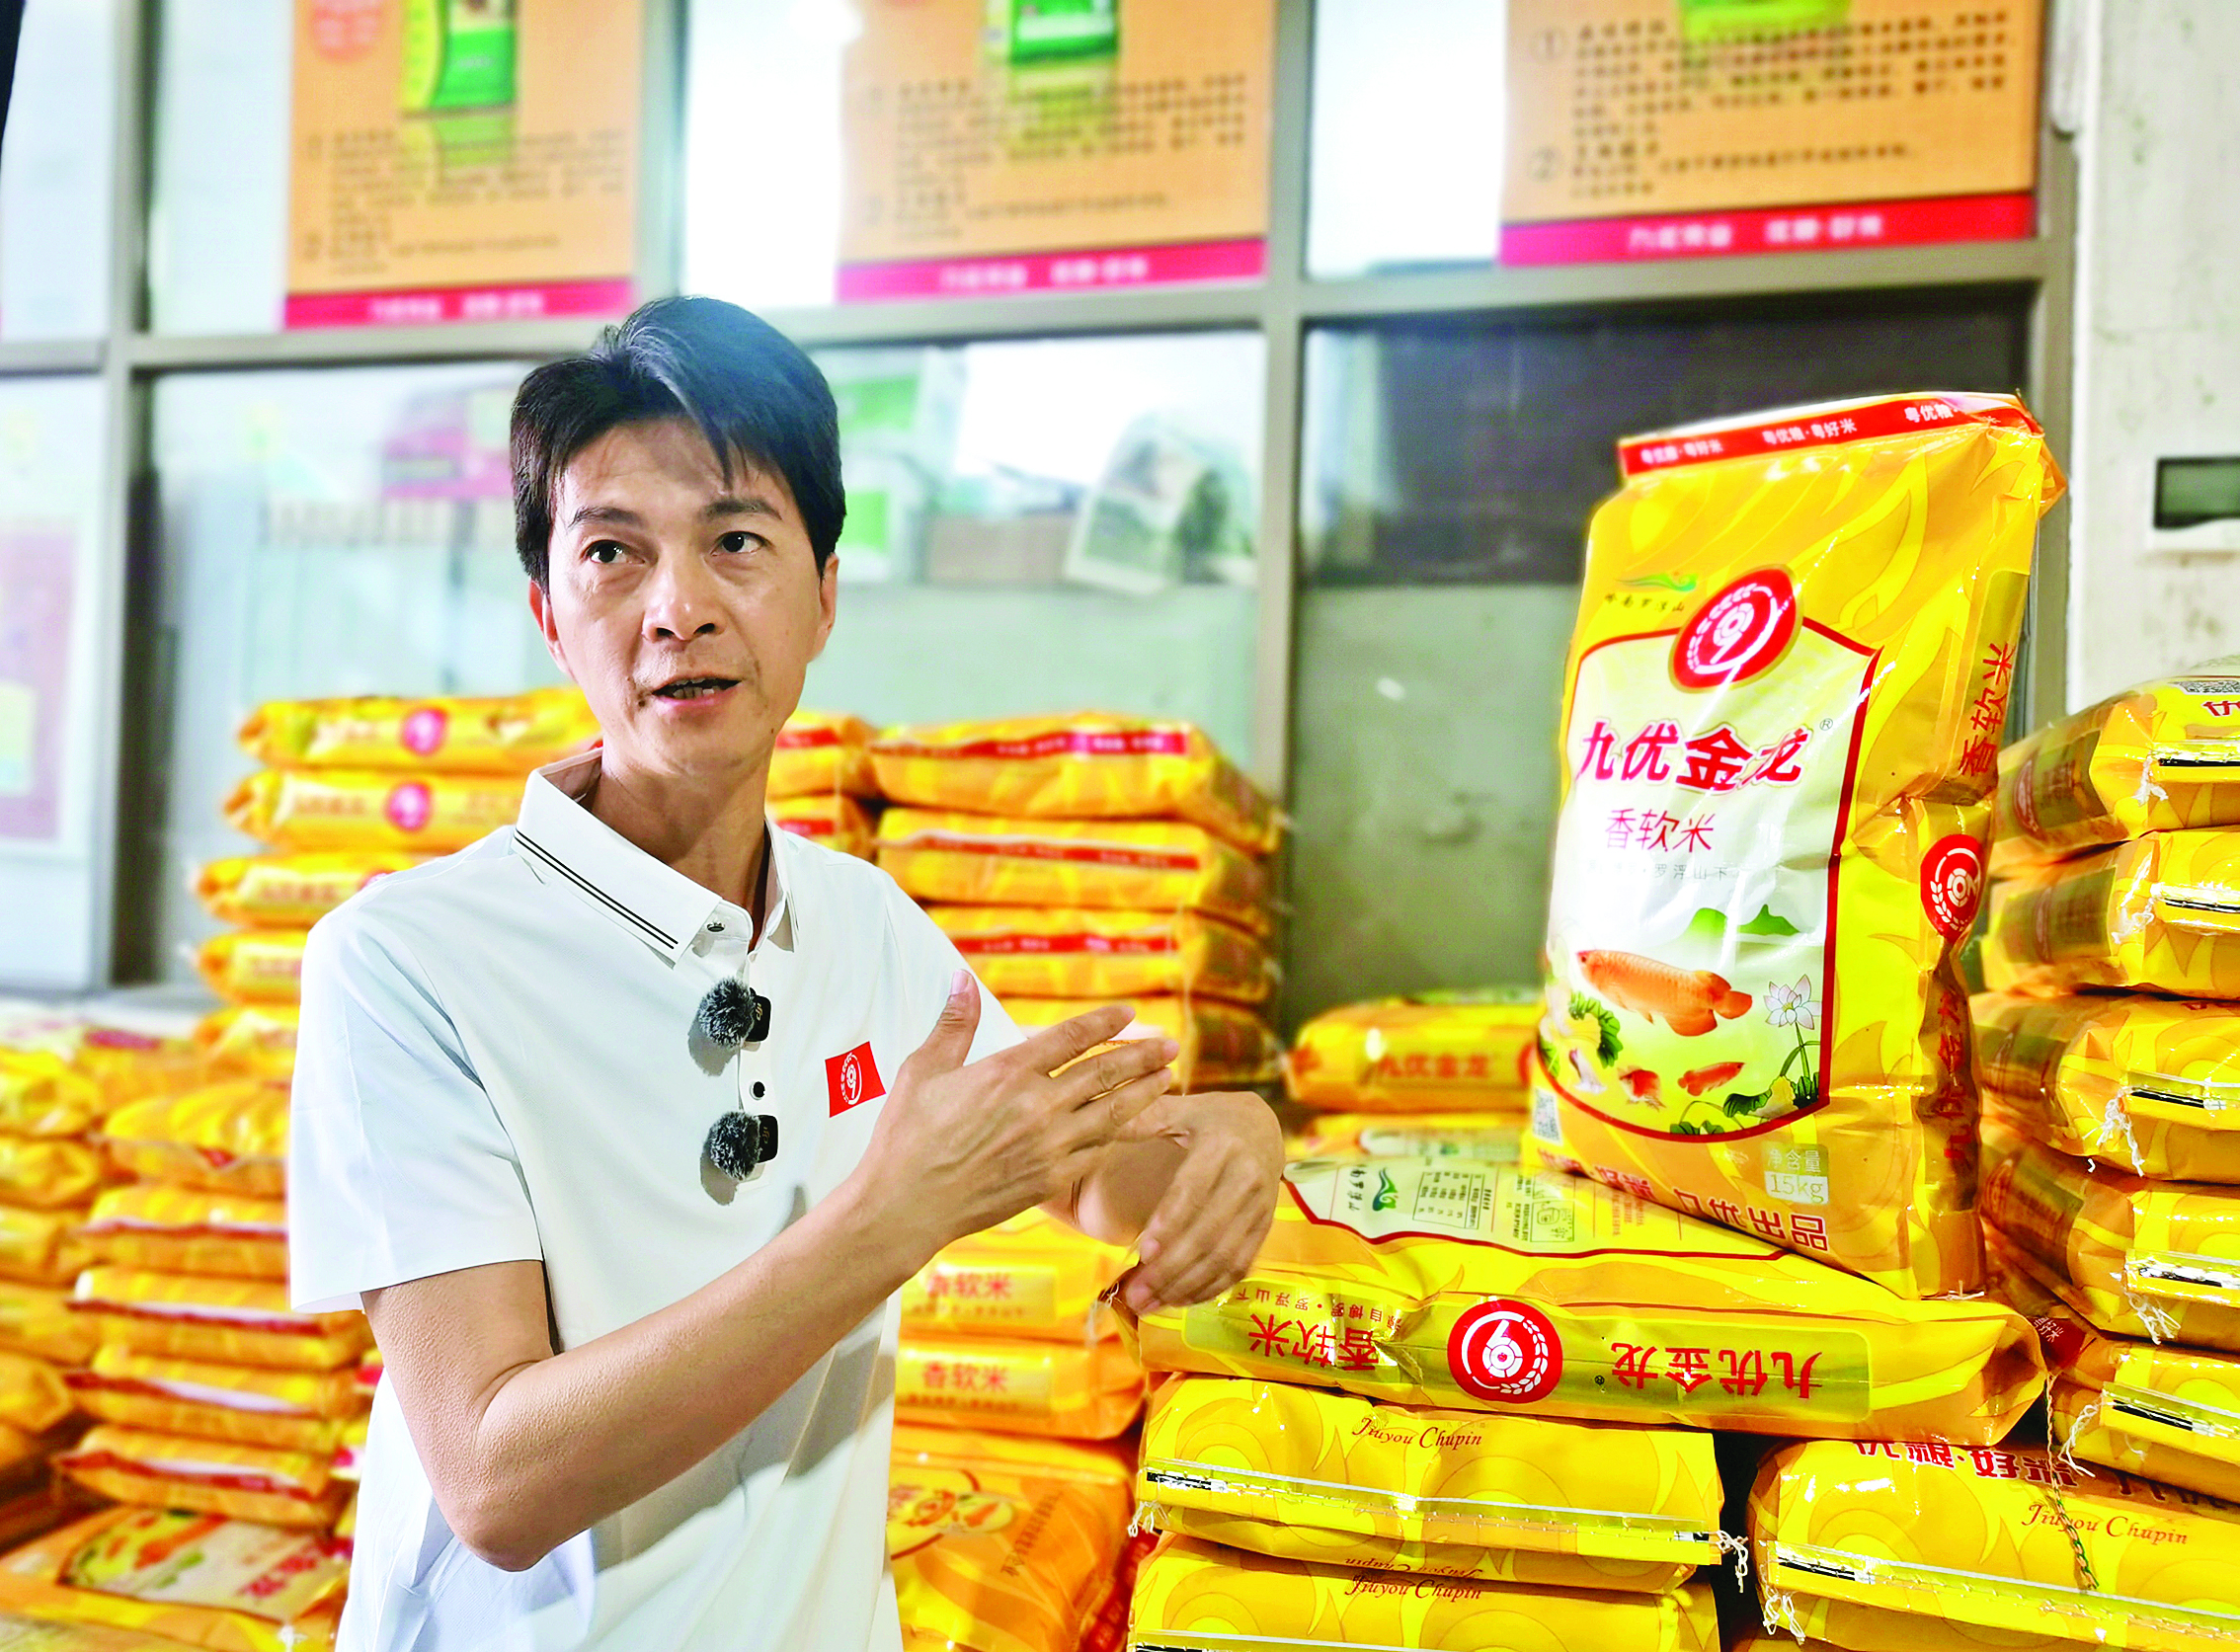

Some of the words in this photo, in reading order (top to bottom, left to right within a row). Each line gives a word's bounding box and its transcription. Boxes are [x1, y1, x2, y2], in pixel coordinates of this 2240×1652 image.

[1762, 419, 1857, 444] 粤优粮·粤好米
[1960, 643, 2016, 776] 香软米
[1575, 721, 1808, 791] 九优金龙
[1606, 809, 1716, 852] 香软米
[1770, 1148, 1821, 1173] 净含量
[1770, 1173, 1824, 1204] 15kg
[1248, 1313, 1379, 1372] 香软米
[921, 1362, 1008, 1393] 香软米
[1611, 1342, 1823, 1399] 九优金龙
[1351, 1417, 1414, 1445] Jiuyou
[1418, 1426, 1482, 1451] Chupin
[2106, 1516, 2188, 1546] Chupin
[1344, 1574, 1408, 1599] Jiuyou
[1414, 1579, 1481, 1603] Chupin
